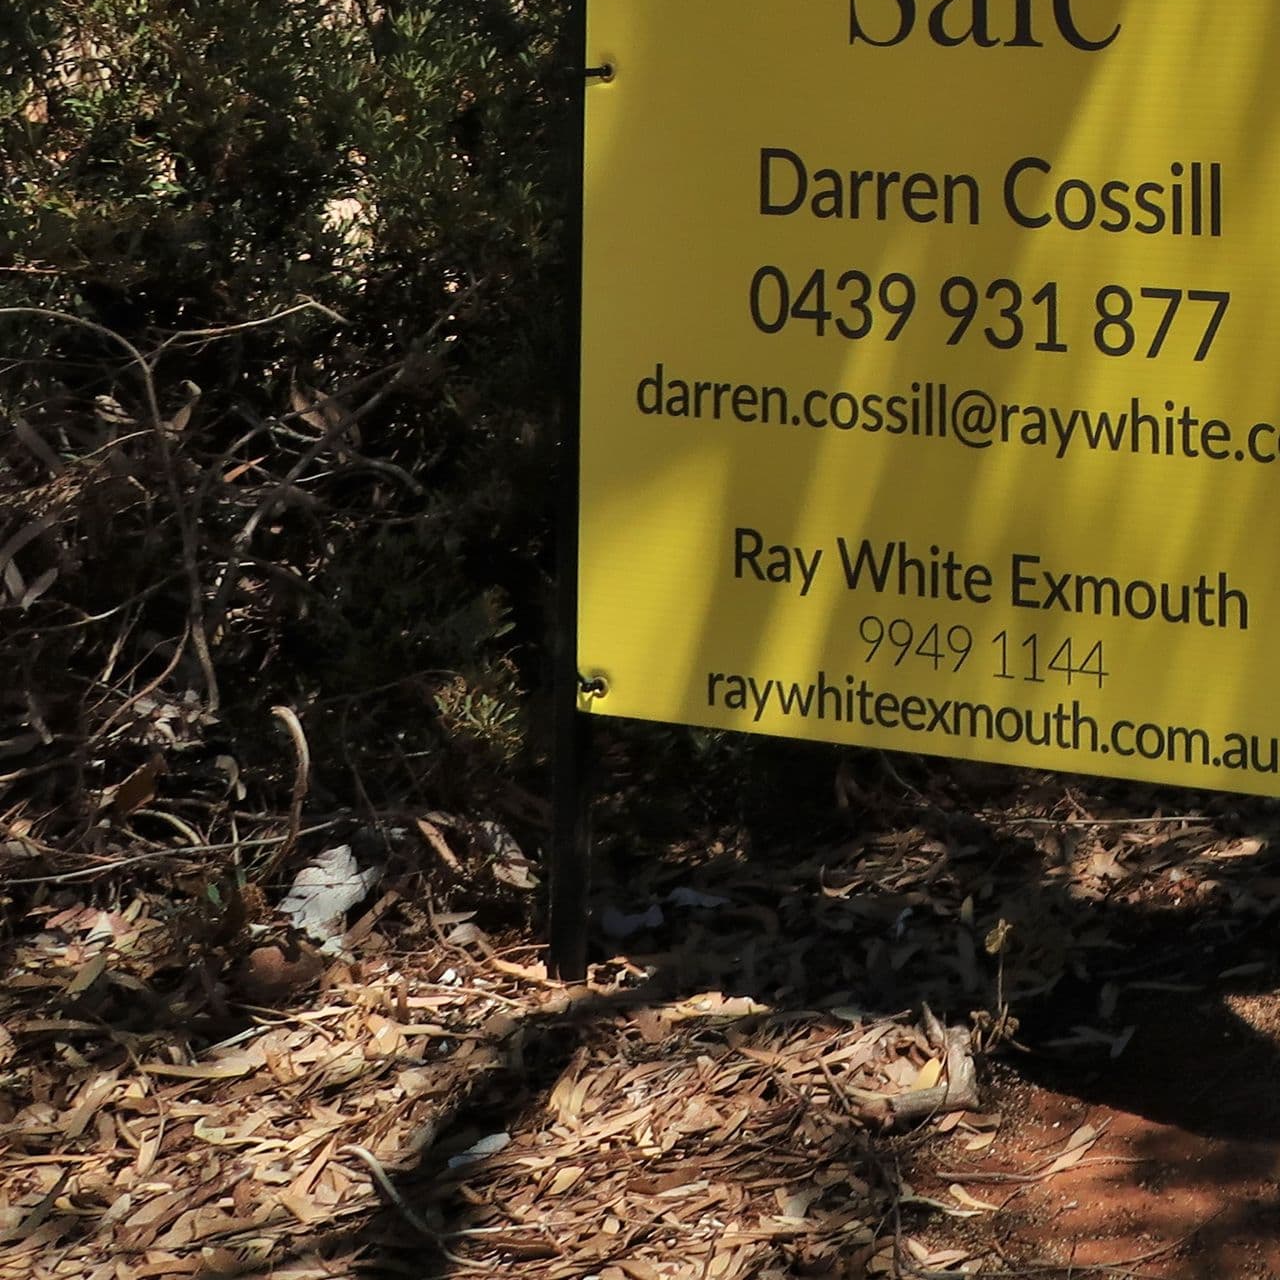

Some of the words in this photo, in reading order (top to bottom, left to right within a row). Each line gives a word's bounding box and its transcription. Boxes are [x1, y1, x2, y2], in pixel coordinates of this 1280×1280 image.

[759, 147, 980, 225] Darren
[1003, 156, 1222, 237] Cossill
[749, 265, 916, 342] 0439
[939, 275, 1068, 353] 931
[1093, 284, 1231, 362] 877
[734, 527, 823, 597] Ray
[836, 537, 993, 604] White
[1011, 553, 1248, 630] Exmouth
[859, 615, 973, 673] 9949
[992, 630, 1109, 689] 1144
[707, 670, 1279, 774] raywhiteexmouth.com.au
